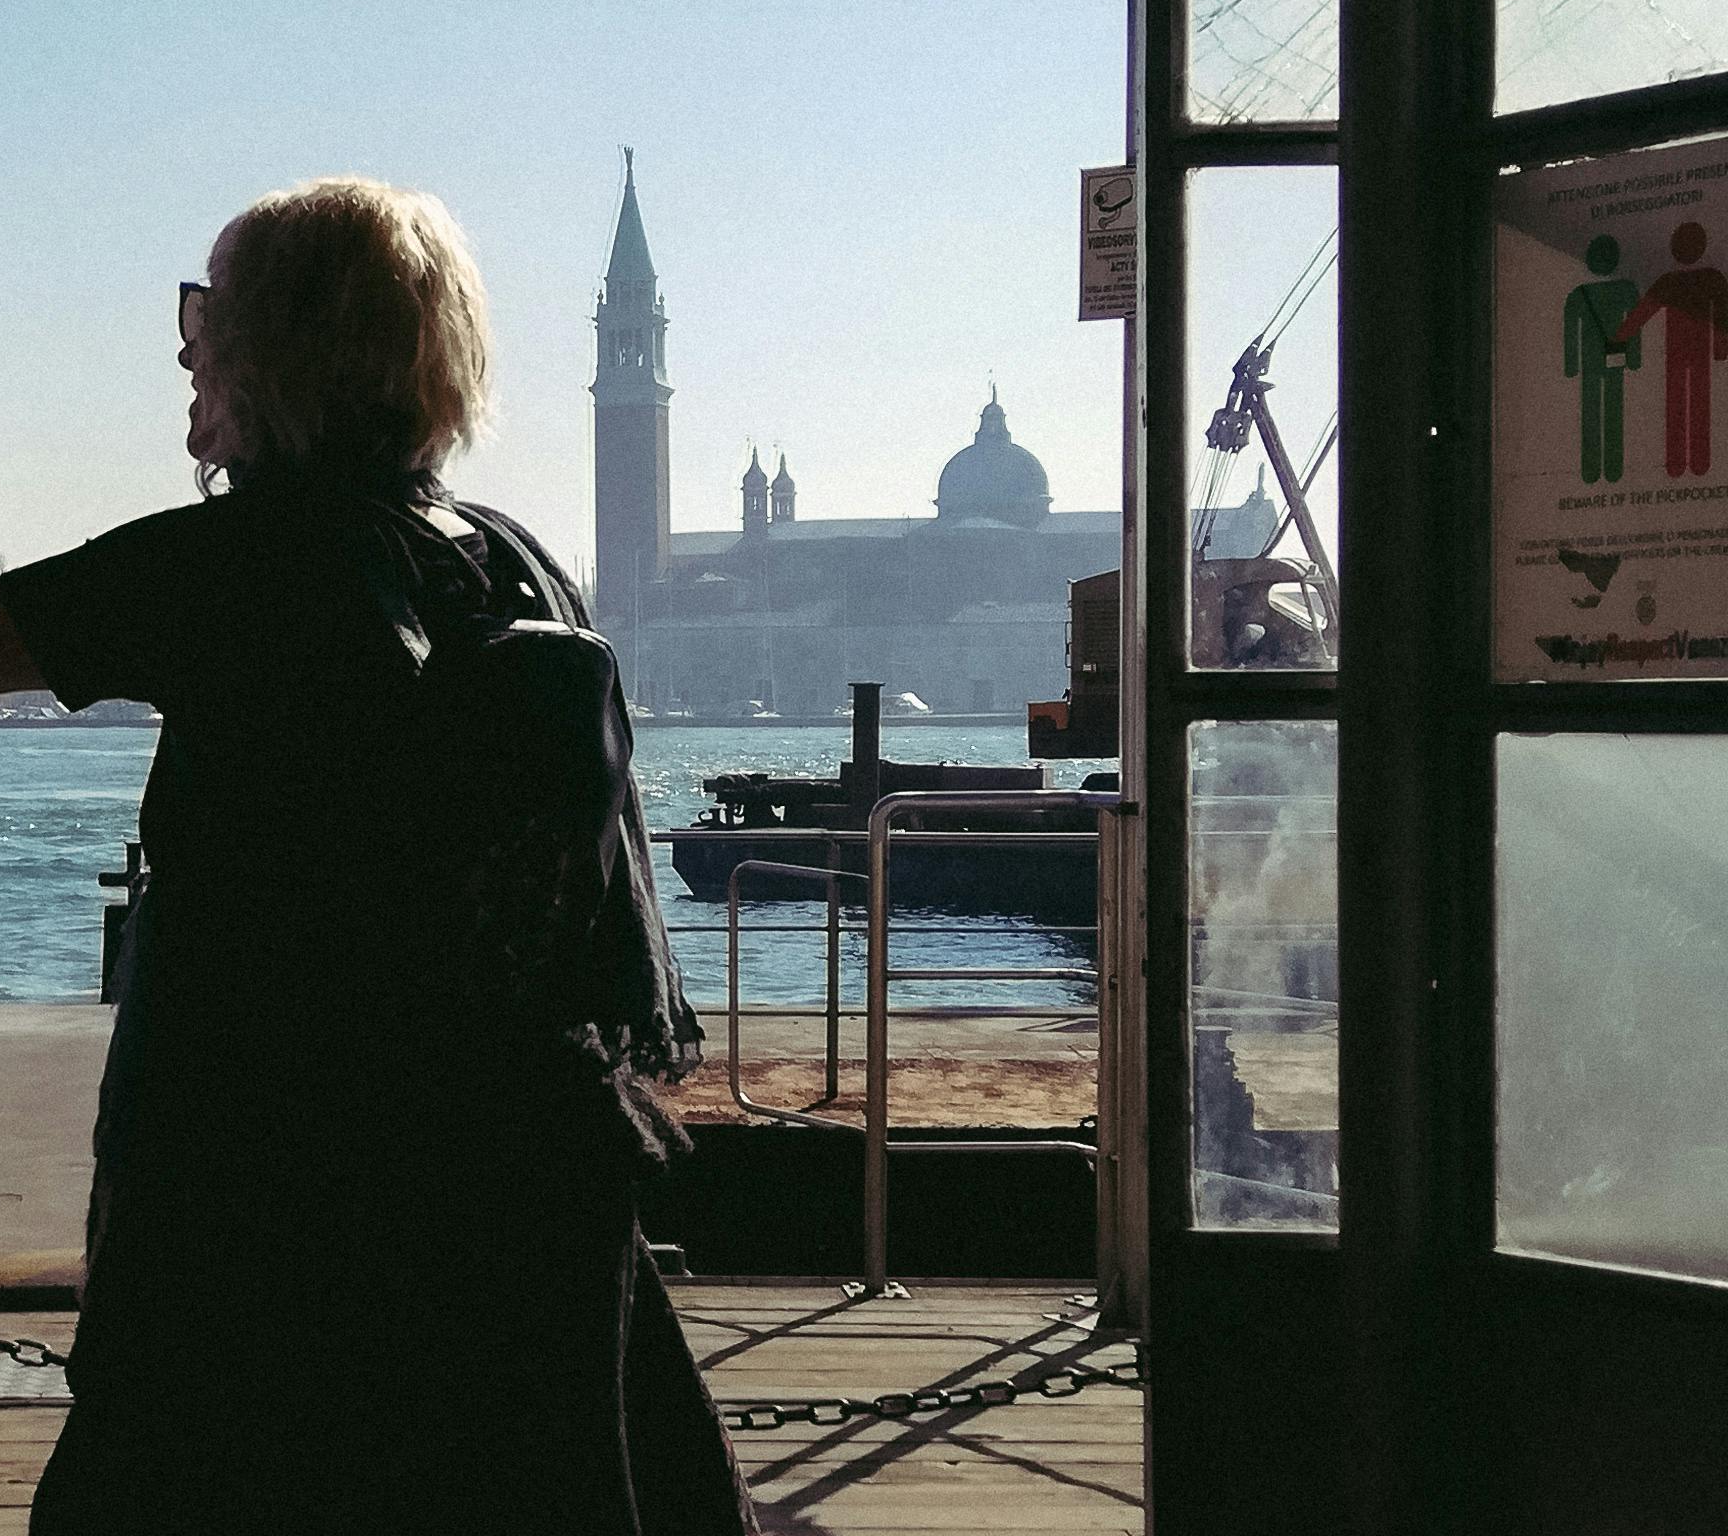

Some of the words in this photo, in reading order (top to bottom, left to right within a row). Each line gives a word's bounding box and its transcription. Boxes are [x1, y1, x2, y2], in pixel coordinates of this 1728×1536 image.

[1548, 181, 1621, 205] ATTENZIONE
[1558, 494, 1607, 511] BEWARE
[1610, 493, 1626, 507] OF
[1630, 491, 1653, 505] THE
